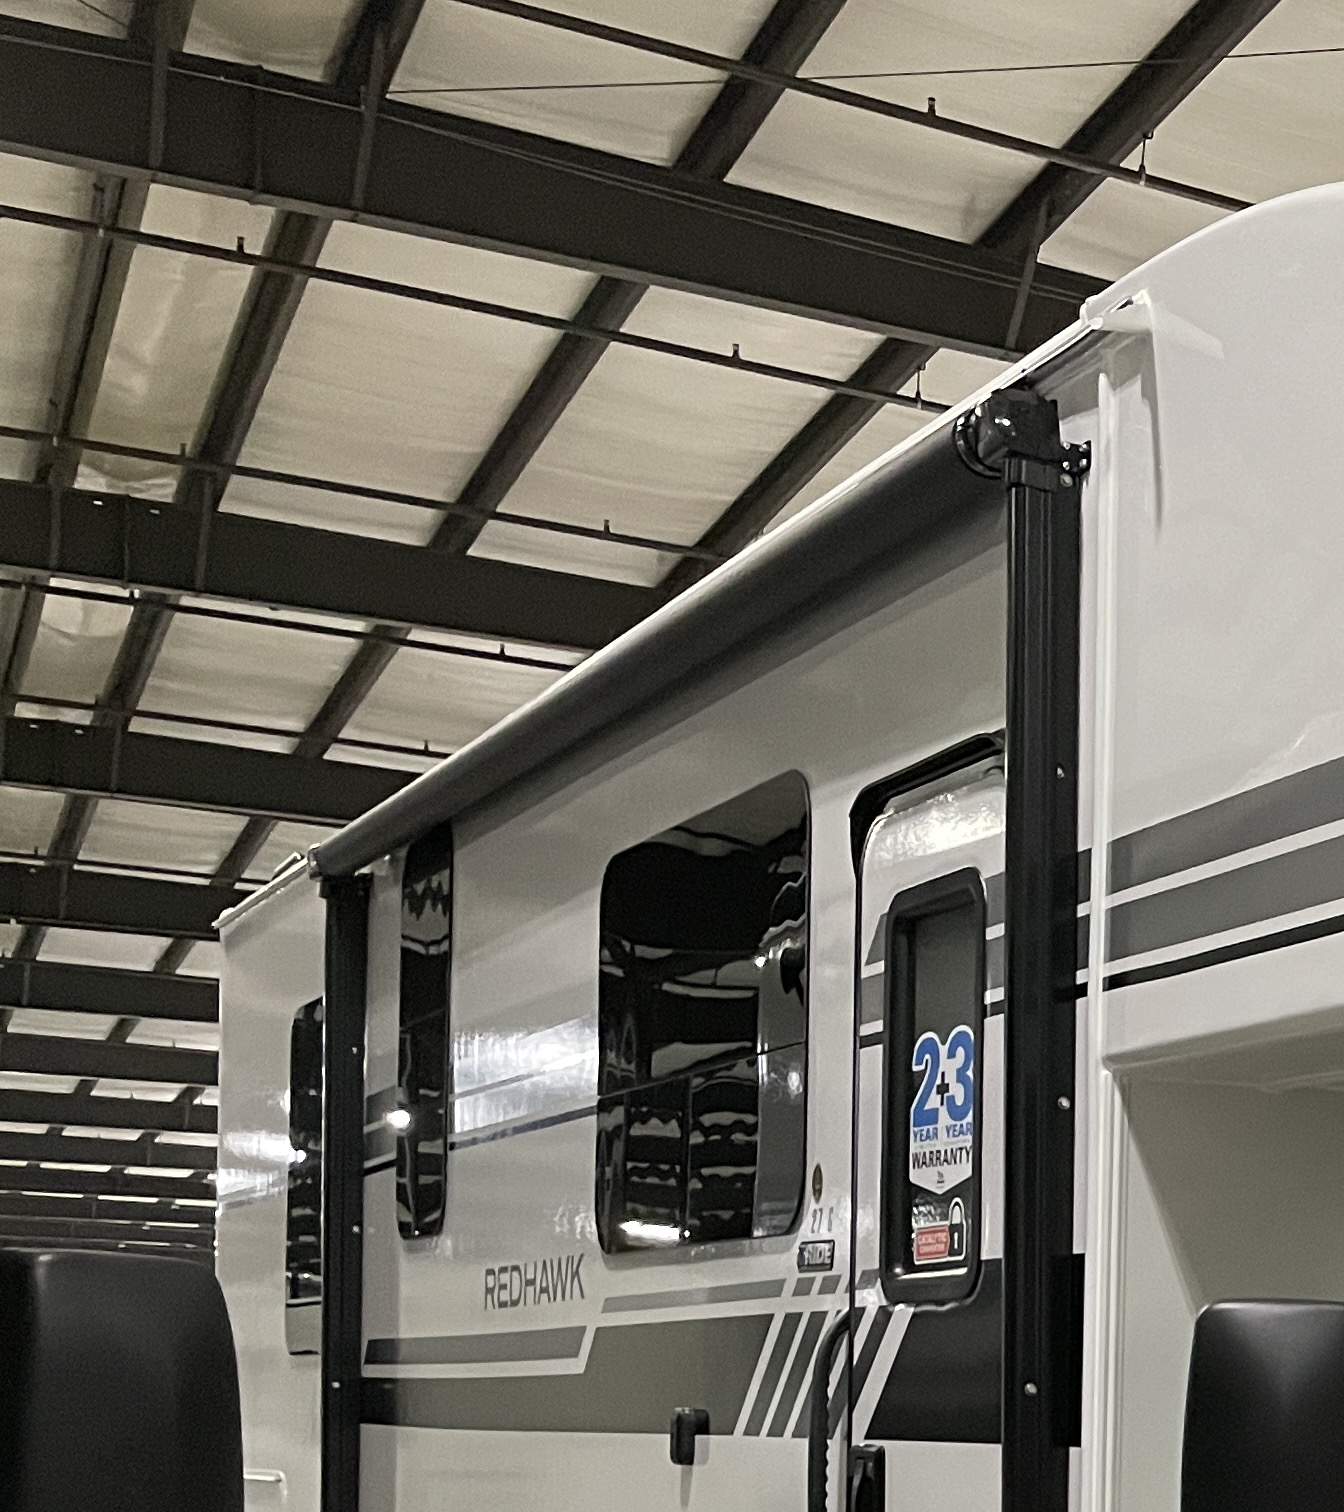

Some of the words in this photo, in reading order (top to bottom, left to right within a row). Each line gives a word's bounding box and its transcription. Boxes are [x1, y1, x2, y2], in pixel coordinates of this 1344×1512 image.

[912, 1126, 939, 1144] YEAR
[945, 1120, 974, 1139] YEAR
[911, 1146, 972, 1169] WARRANTY
[484, 1253, 586, 1311] REDHAWK
